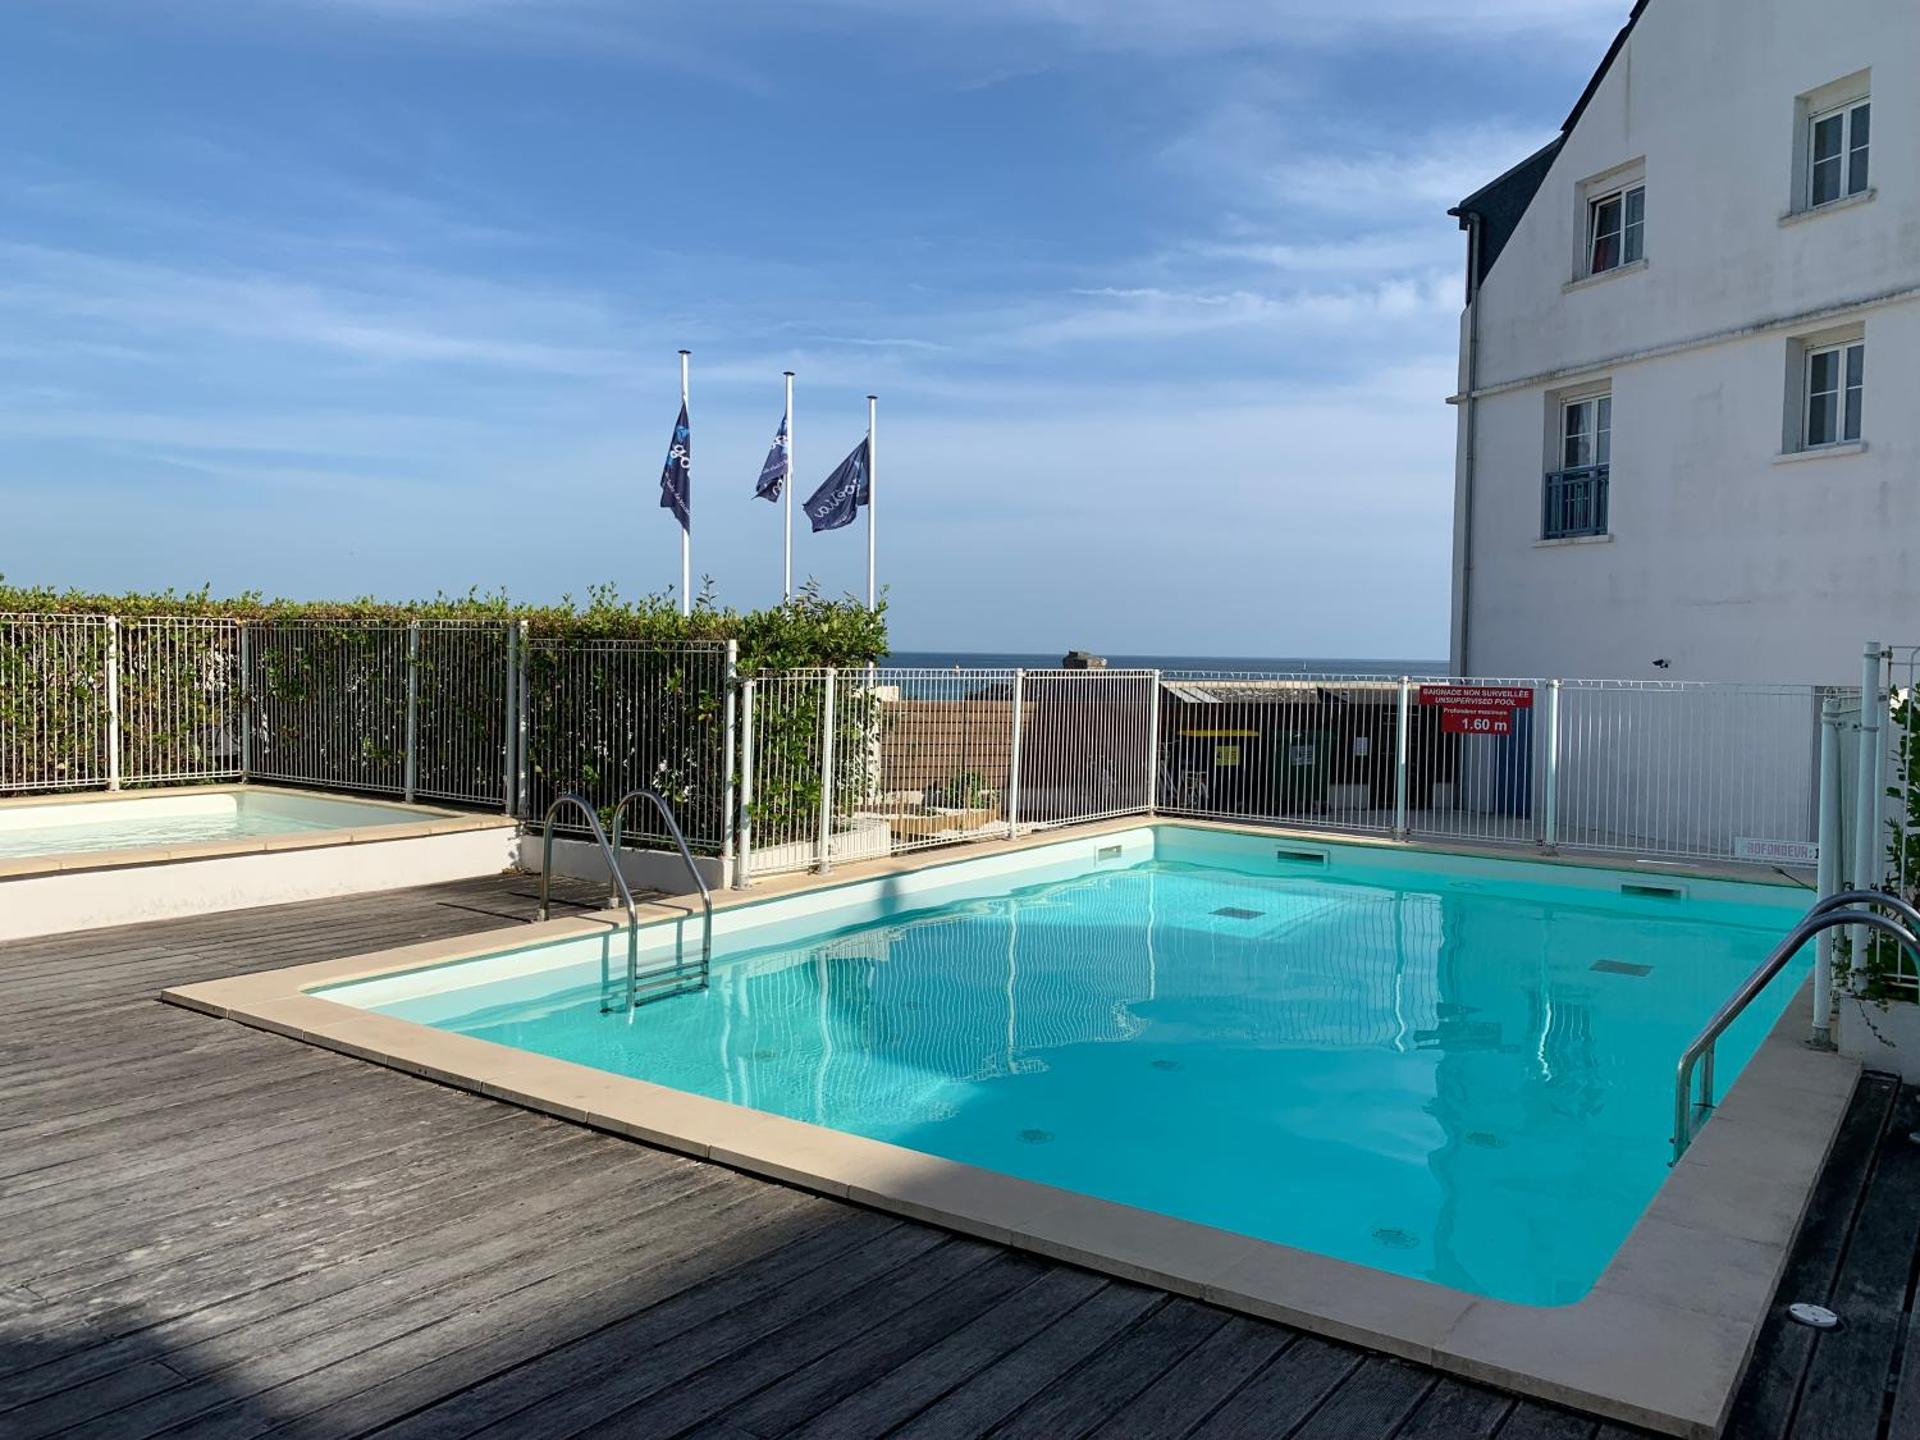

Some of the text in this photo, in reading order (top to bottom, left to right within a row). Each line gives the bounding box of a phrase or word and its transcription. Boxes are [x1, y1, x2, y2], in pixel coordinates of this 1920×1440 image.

[1423, 688, 1462, 696] BAIGNADE
[1481, 690, 1530, 698] SURVEILLÉE
[1435, 697, 1516, 706] UNSUPERVISED POOL
[1462, 718, 1508, 732] 1.60 m
